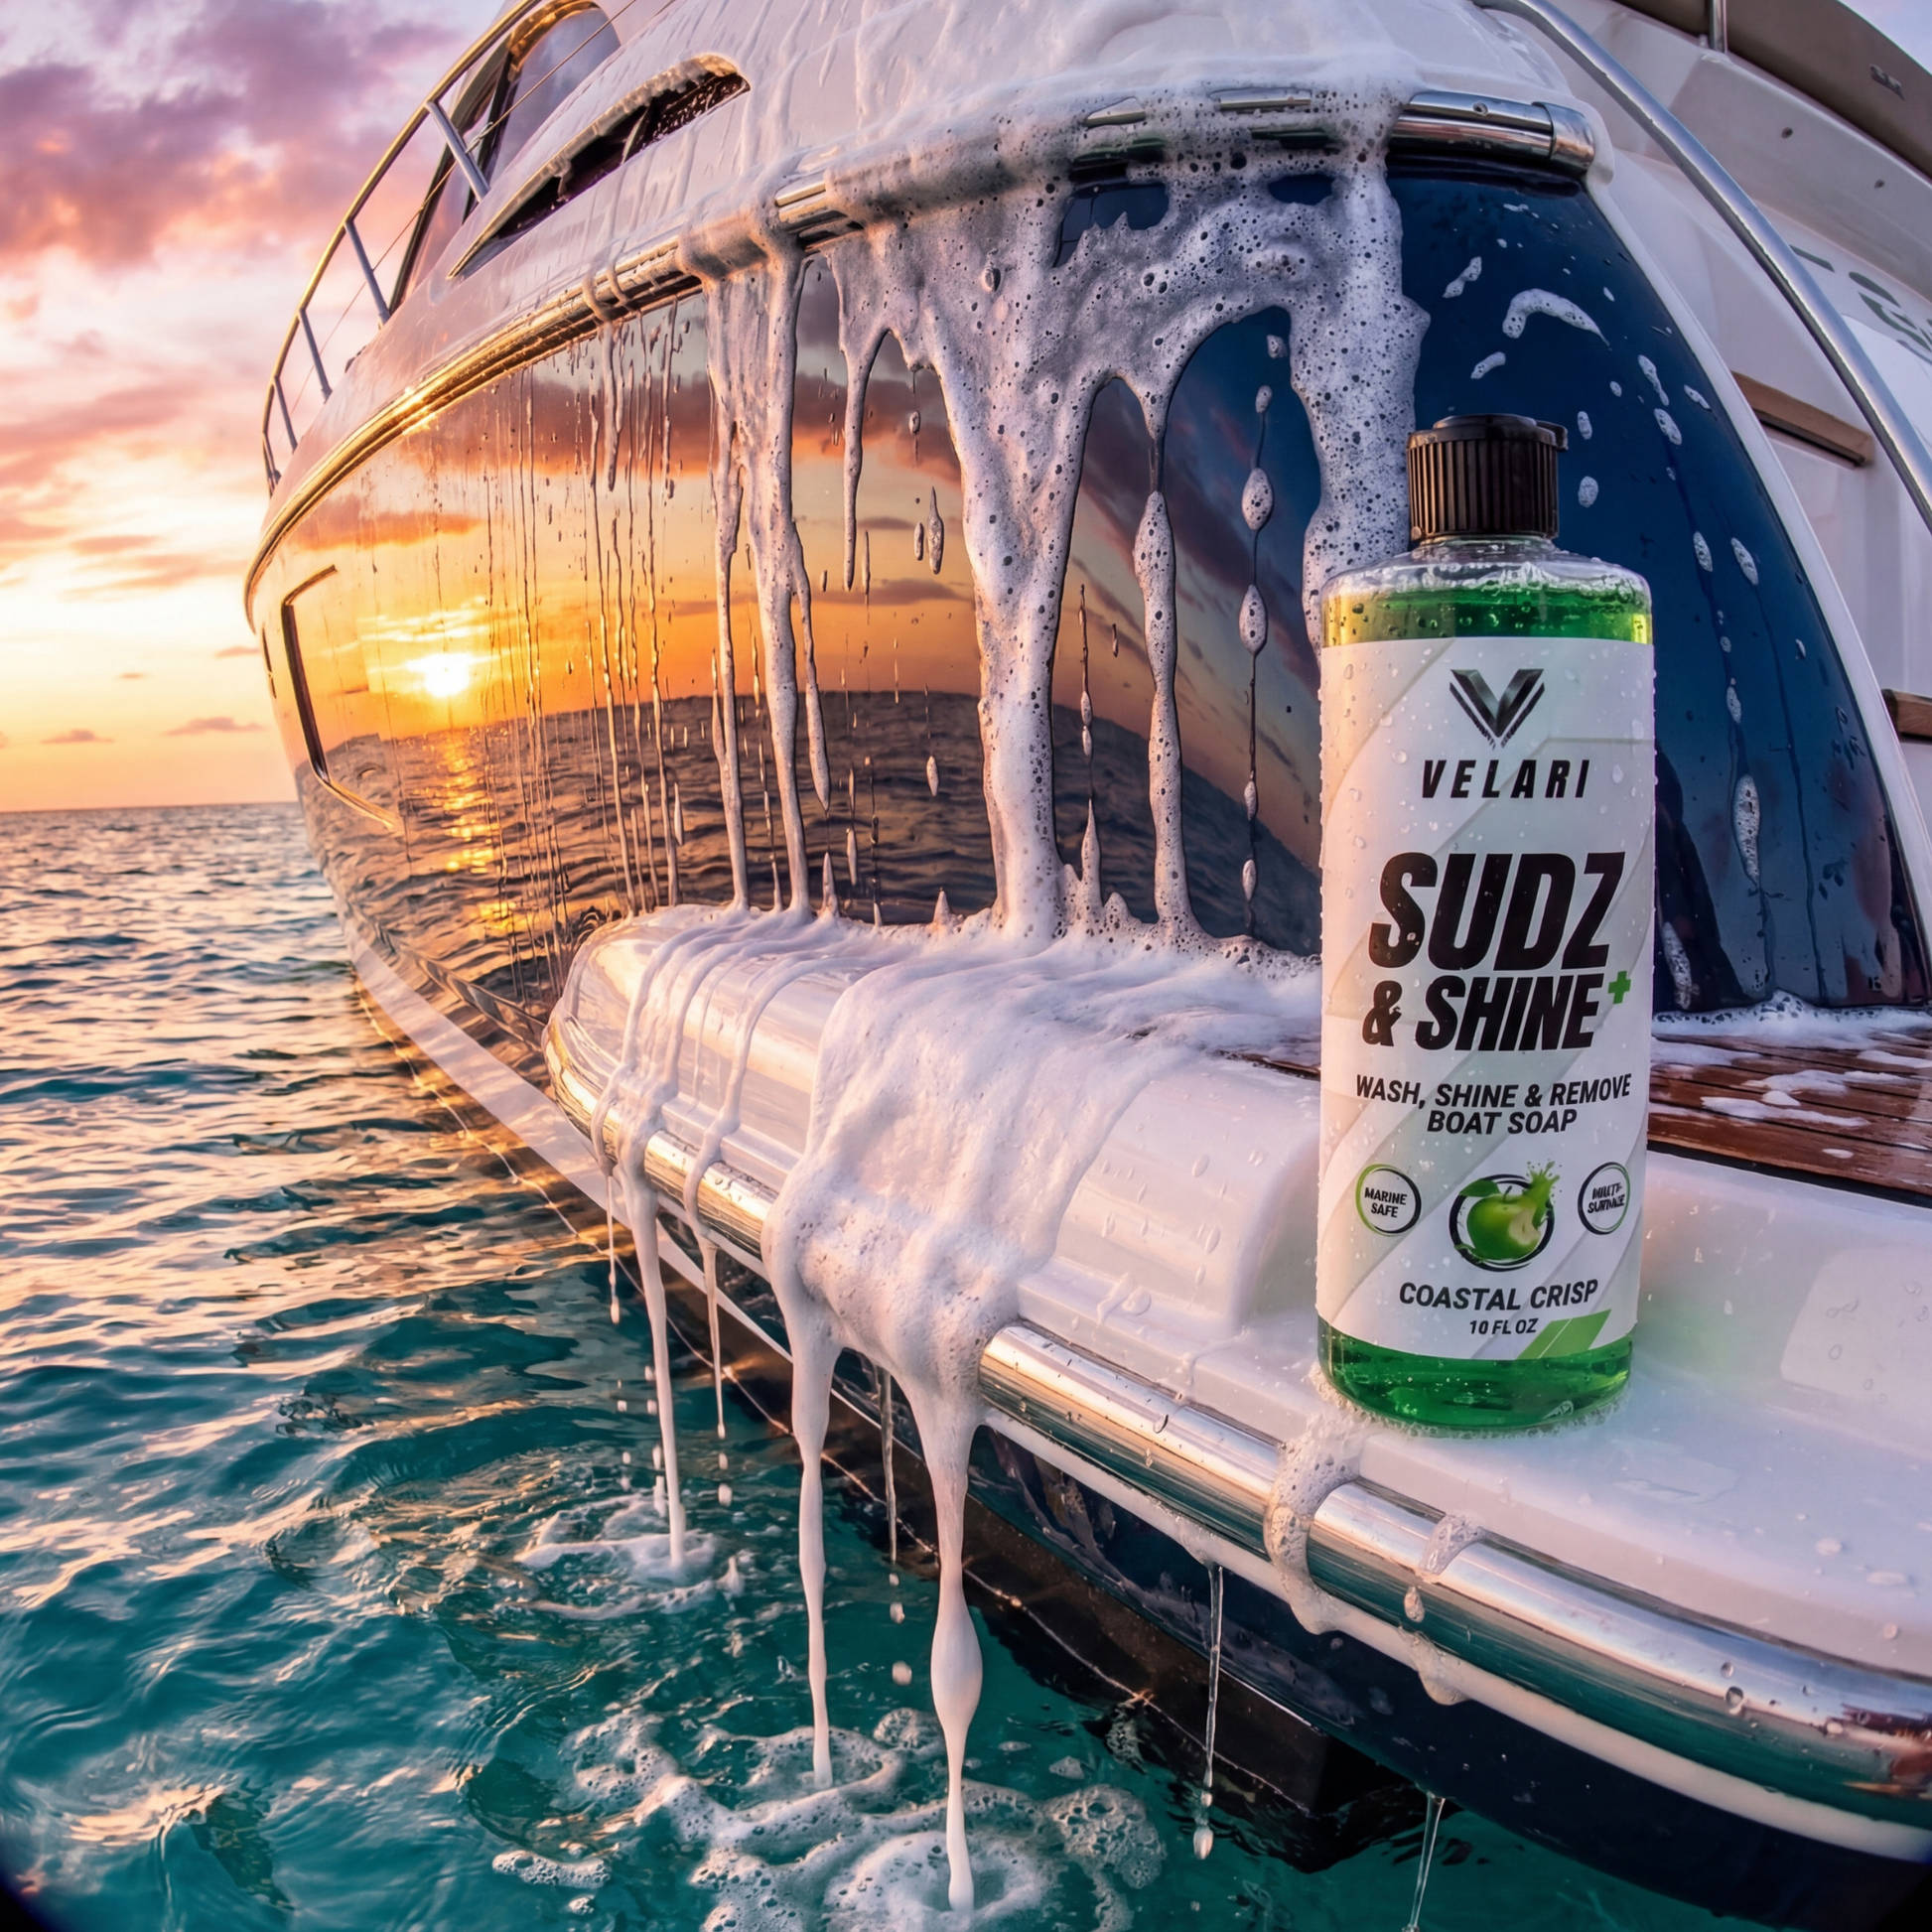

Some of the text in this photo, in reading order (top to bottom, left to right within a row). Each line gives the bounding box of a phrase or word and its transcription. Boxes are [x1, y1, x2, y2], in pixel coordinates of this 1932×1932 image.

[1422, 759, 1590, 798] VELARI
[1368, 851, 1626, 971] SUDZ
[1362, 980, 1403, 1047] &
[1356, 1072, 1632, 1110] WASH, SHINE & REMOVE
[1426, 1108, 1578, 1136] BOAT SOAP
[1364, 1186, 1408, 1206] MARINE
[1370, 1201, 1399, 1218] SAFE
[1399, 1278, 1599, 1311] COASTAL CRISP
[1469, 1317, 1540, 1335] 10 FL OZ
